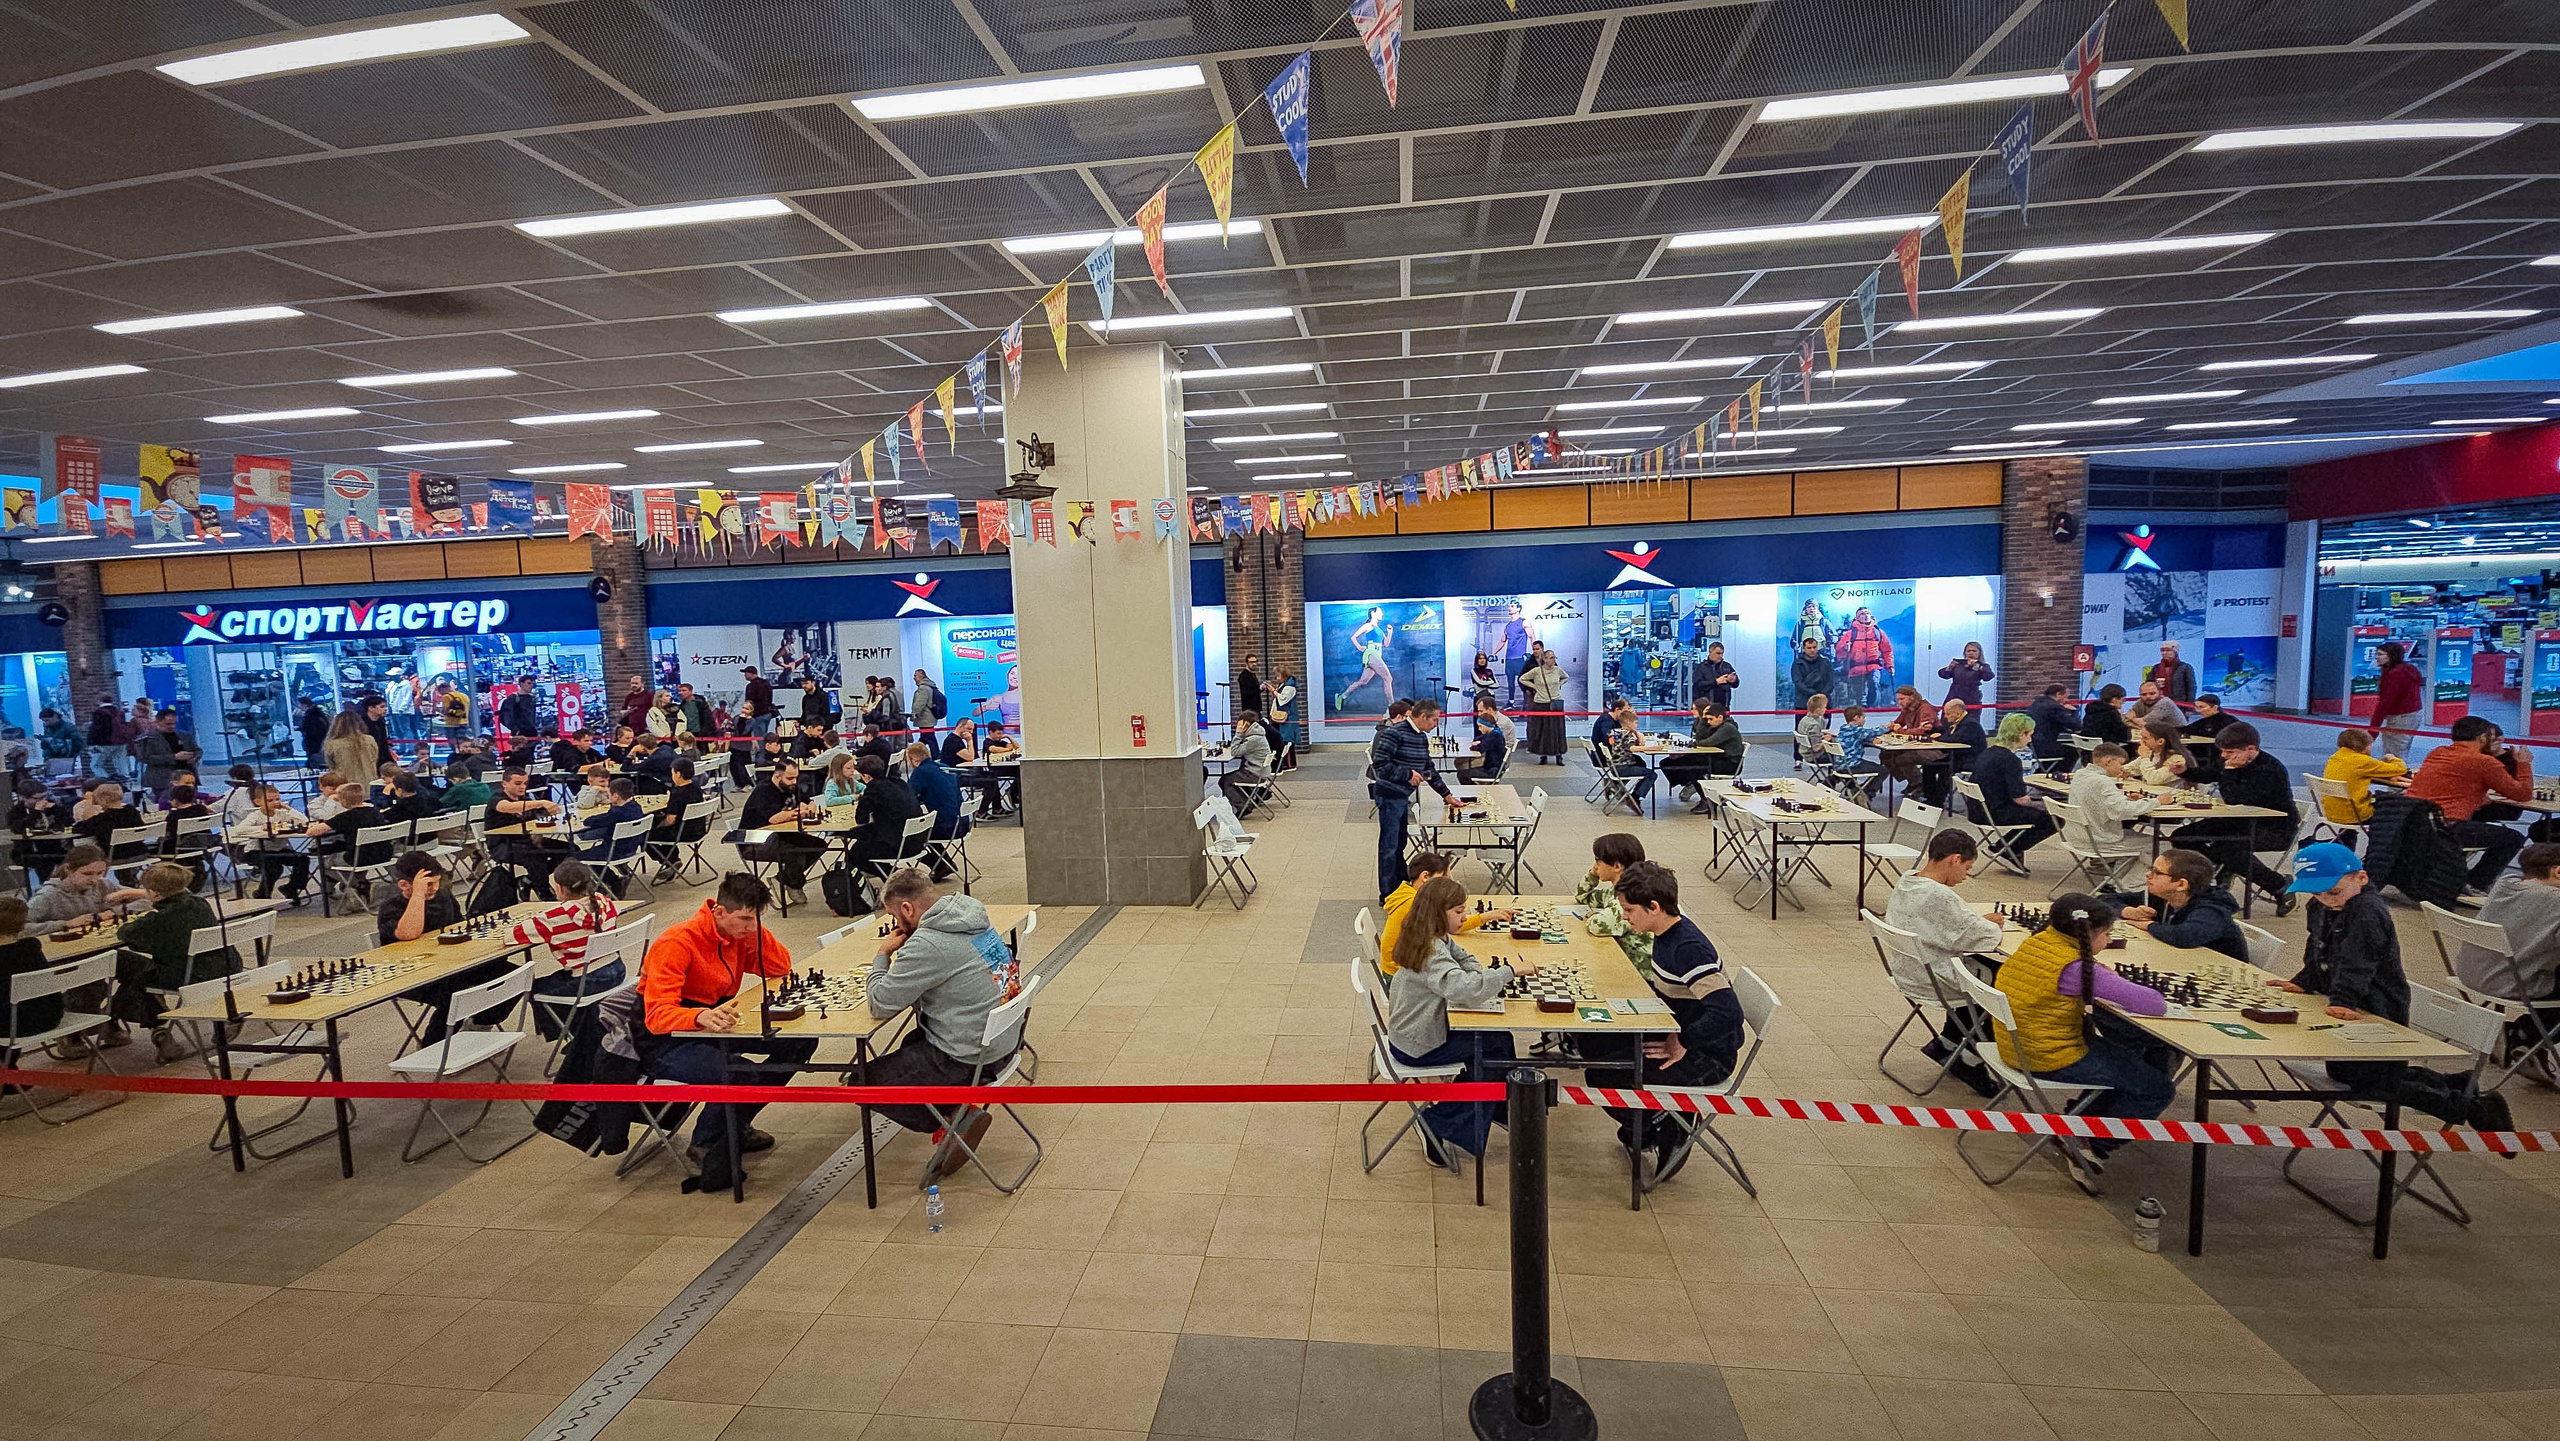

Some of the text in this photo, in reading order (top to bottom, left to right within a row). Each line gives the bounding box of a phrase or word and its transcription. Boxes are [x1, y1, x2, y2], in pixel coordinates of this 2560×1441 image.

[1272, 67, 1307, 112] STUDY
[1278, 101, 1308, 132] COOL
[2002, 116, 2029, 158] STUDY
[1203, 137, 1231, 178] LITTLE
[2008, 147, 2031, 175] COOL
[1142, 195, 1163, 230] GOOD
[1145, 222, 1162, 250] DAY
[1089, 245, 1114, 278] PARTY
[1847, 587, 1913, 597] NORTHLAND
[2223, 597, 2271, 607] PROTEST
[1534, 612, 1584, 621] ATHLEX
[2082, 603, 2110, 614] DWAY
[1401, 622, 1443, 631] DEMIX
[701, 655, 749, 665] STERN
